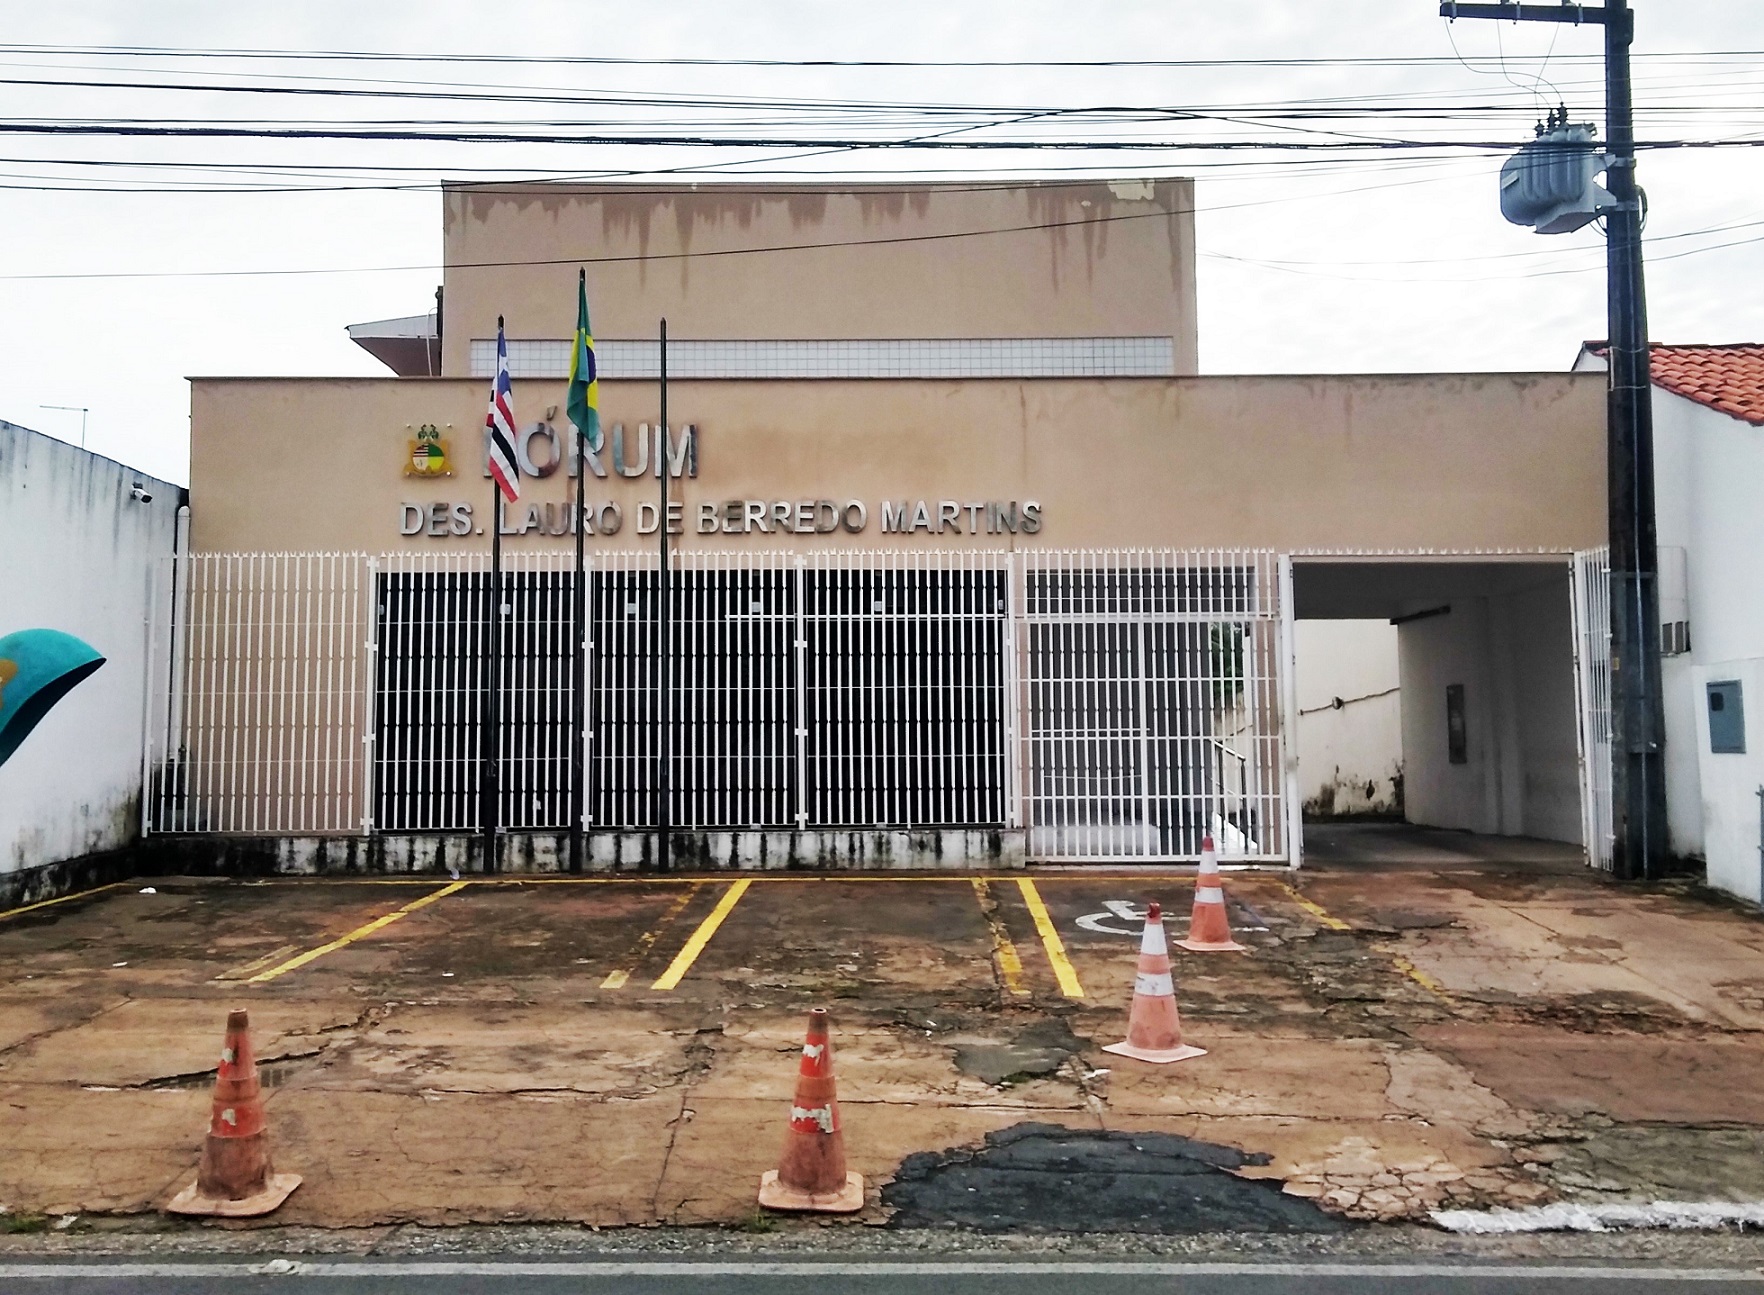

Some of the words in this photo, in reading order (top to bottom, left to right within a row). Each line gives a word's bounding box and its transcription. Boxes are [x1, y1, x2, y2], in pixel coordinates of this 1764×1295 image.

[401, 502, 483, 536] DES.
[499, 501, 623, 536] LAURO
[637, 501, 683, 535] DE
[697, 499, 867, 534] BERREDO
[881, 500, 1041, 534] MARTINS
